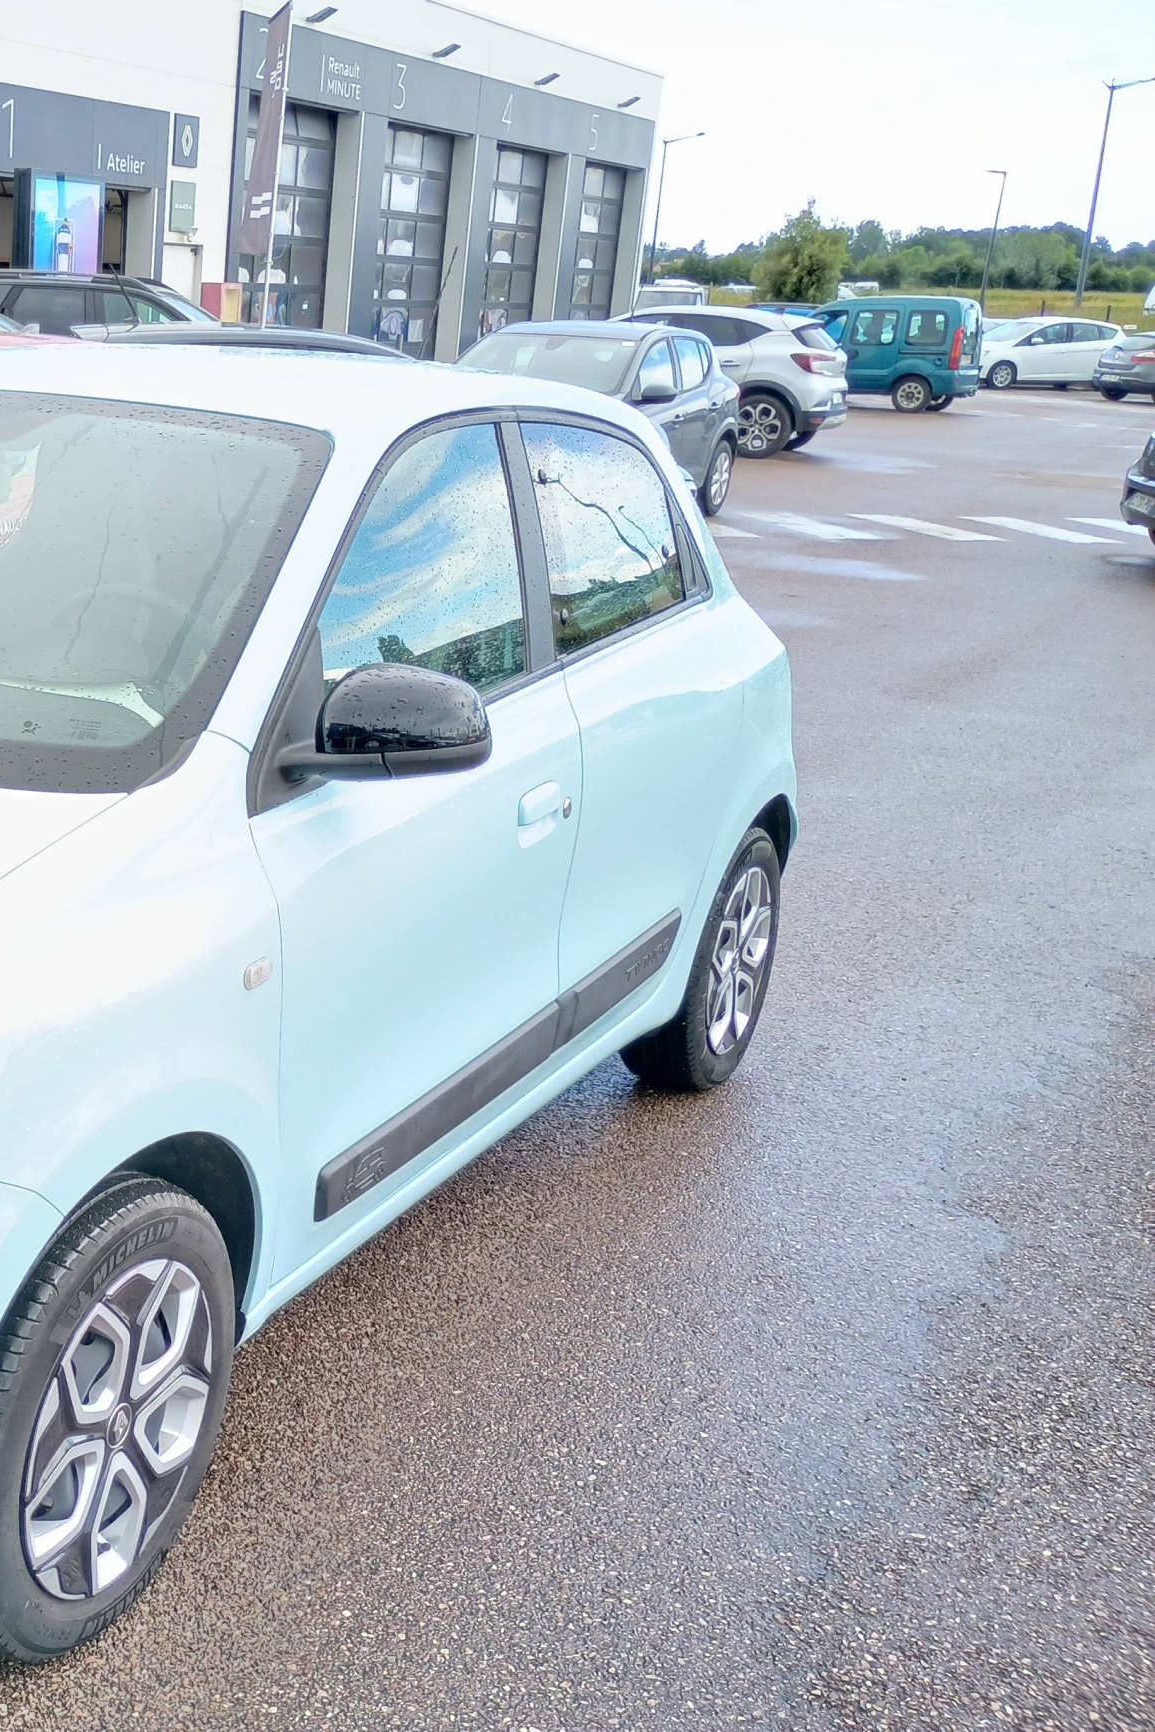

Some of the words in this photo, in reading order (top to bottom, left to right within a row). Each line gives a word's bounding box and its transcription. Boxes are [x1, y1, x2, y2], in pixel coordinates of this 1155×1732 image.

[328, 57, 361, 79] Renault
[392, 63, 407, 109] 3
[327, 78, 361, 100] MINUTE
[1, 98, 15, 159] 1
[501, 93, 513, 132] 4
[589, 113, 599, 150] 5
[106, 152, 146, 175] Atelier
[92, 1220, 175, 1291] MICHELIN
